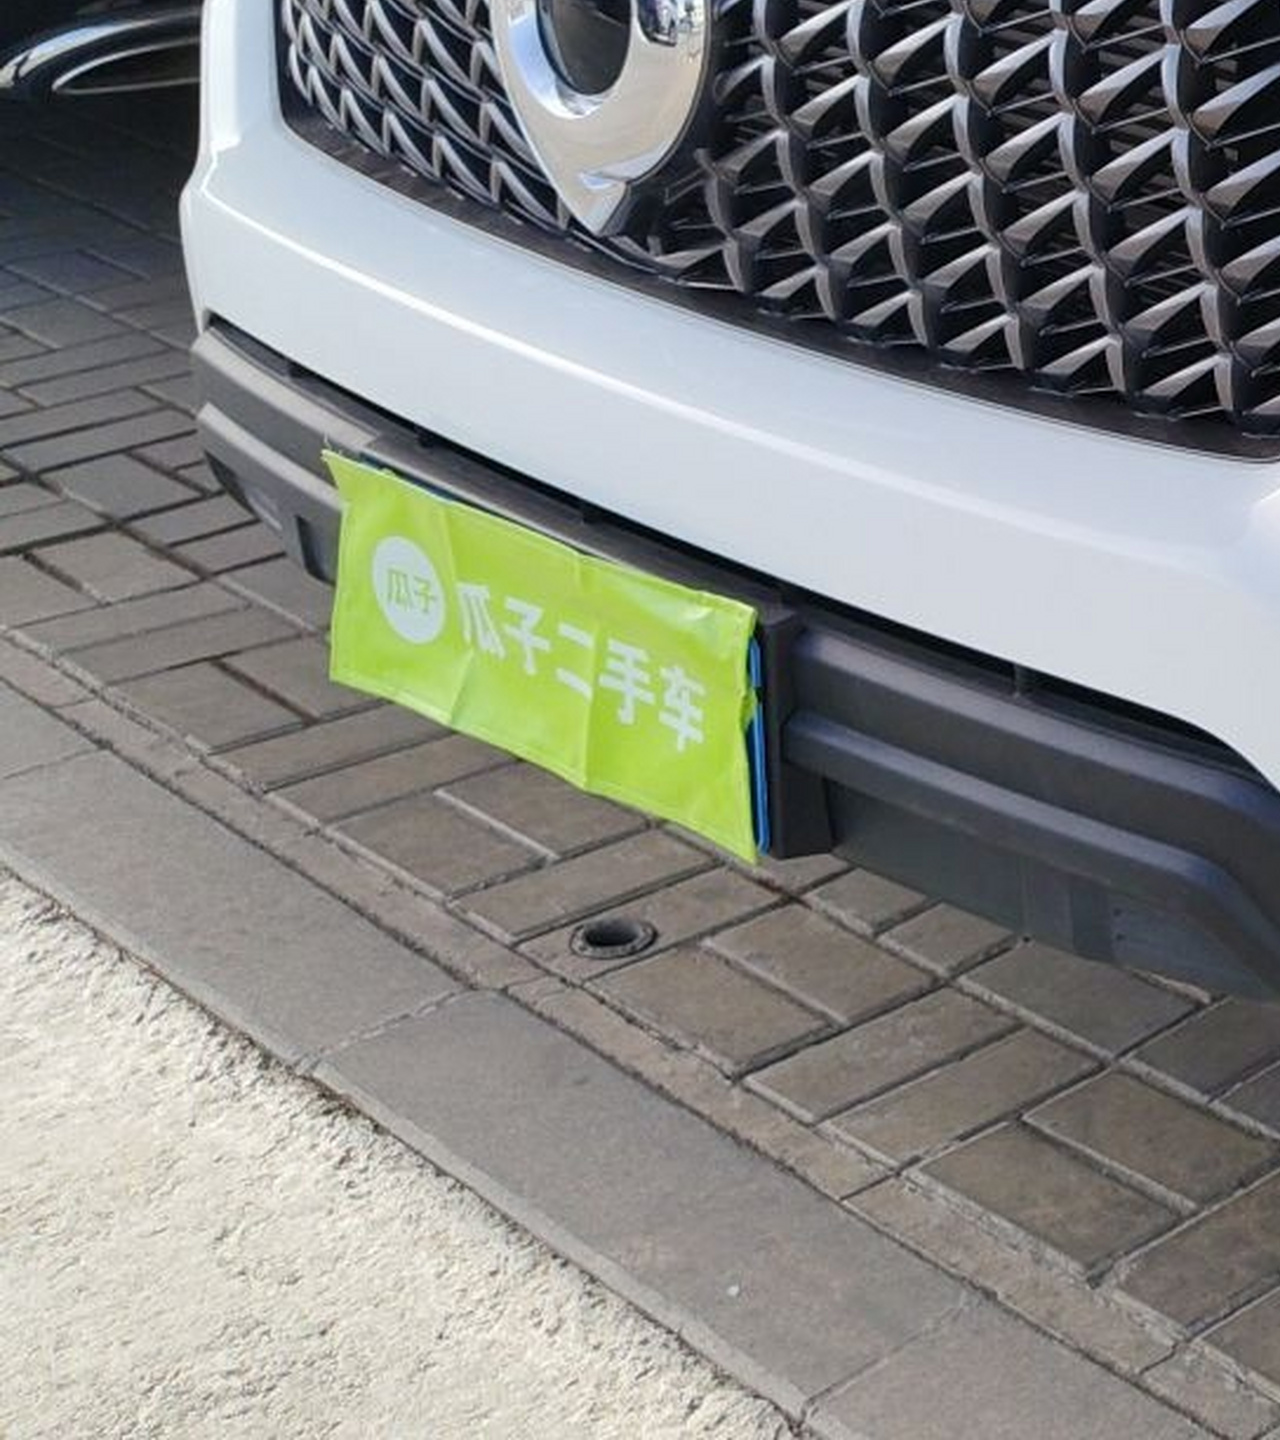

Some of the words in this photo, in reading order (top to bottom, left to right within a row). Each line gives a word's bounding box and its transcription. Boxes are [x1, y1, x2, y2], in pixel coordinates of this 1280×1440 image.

[386, 568, 437, 615] 瓜子
[454, 580, 707, 754] 瓜子二手车
